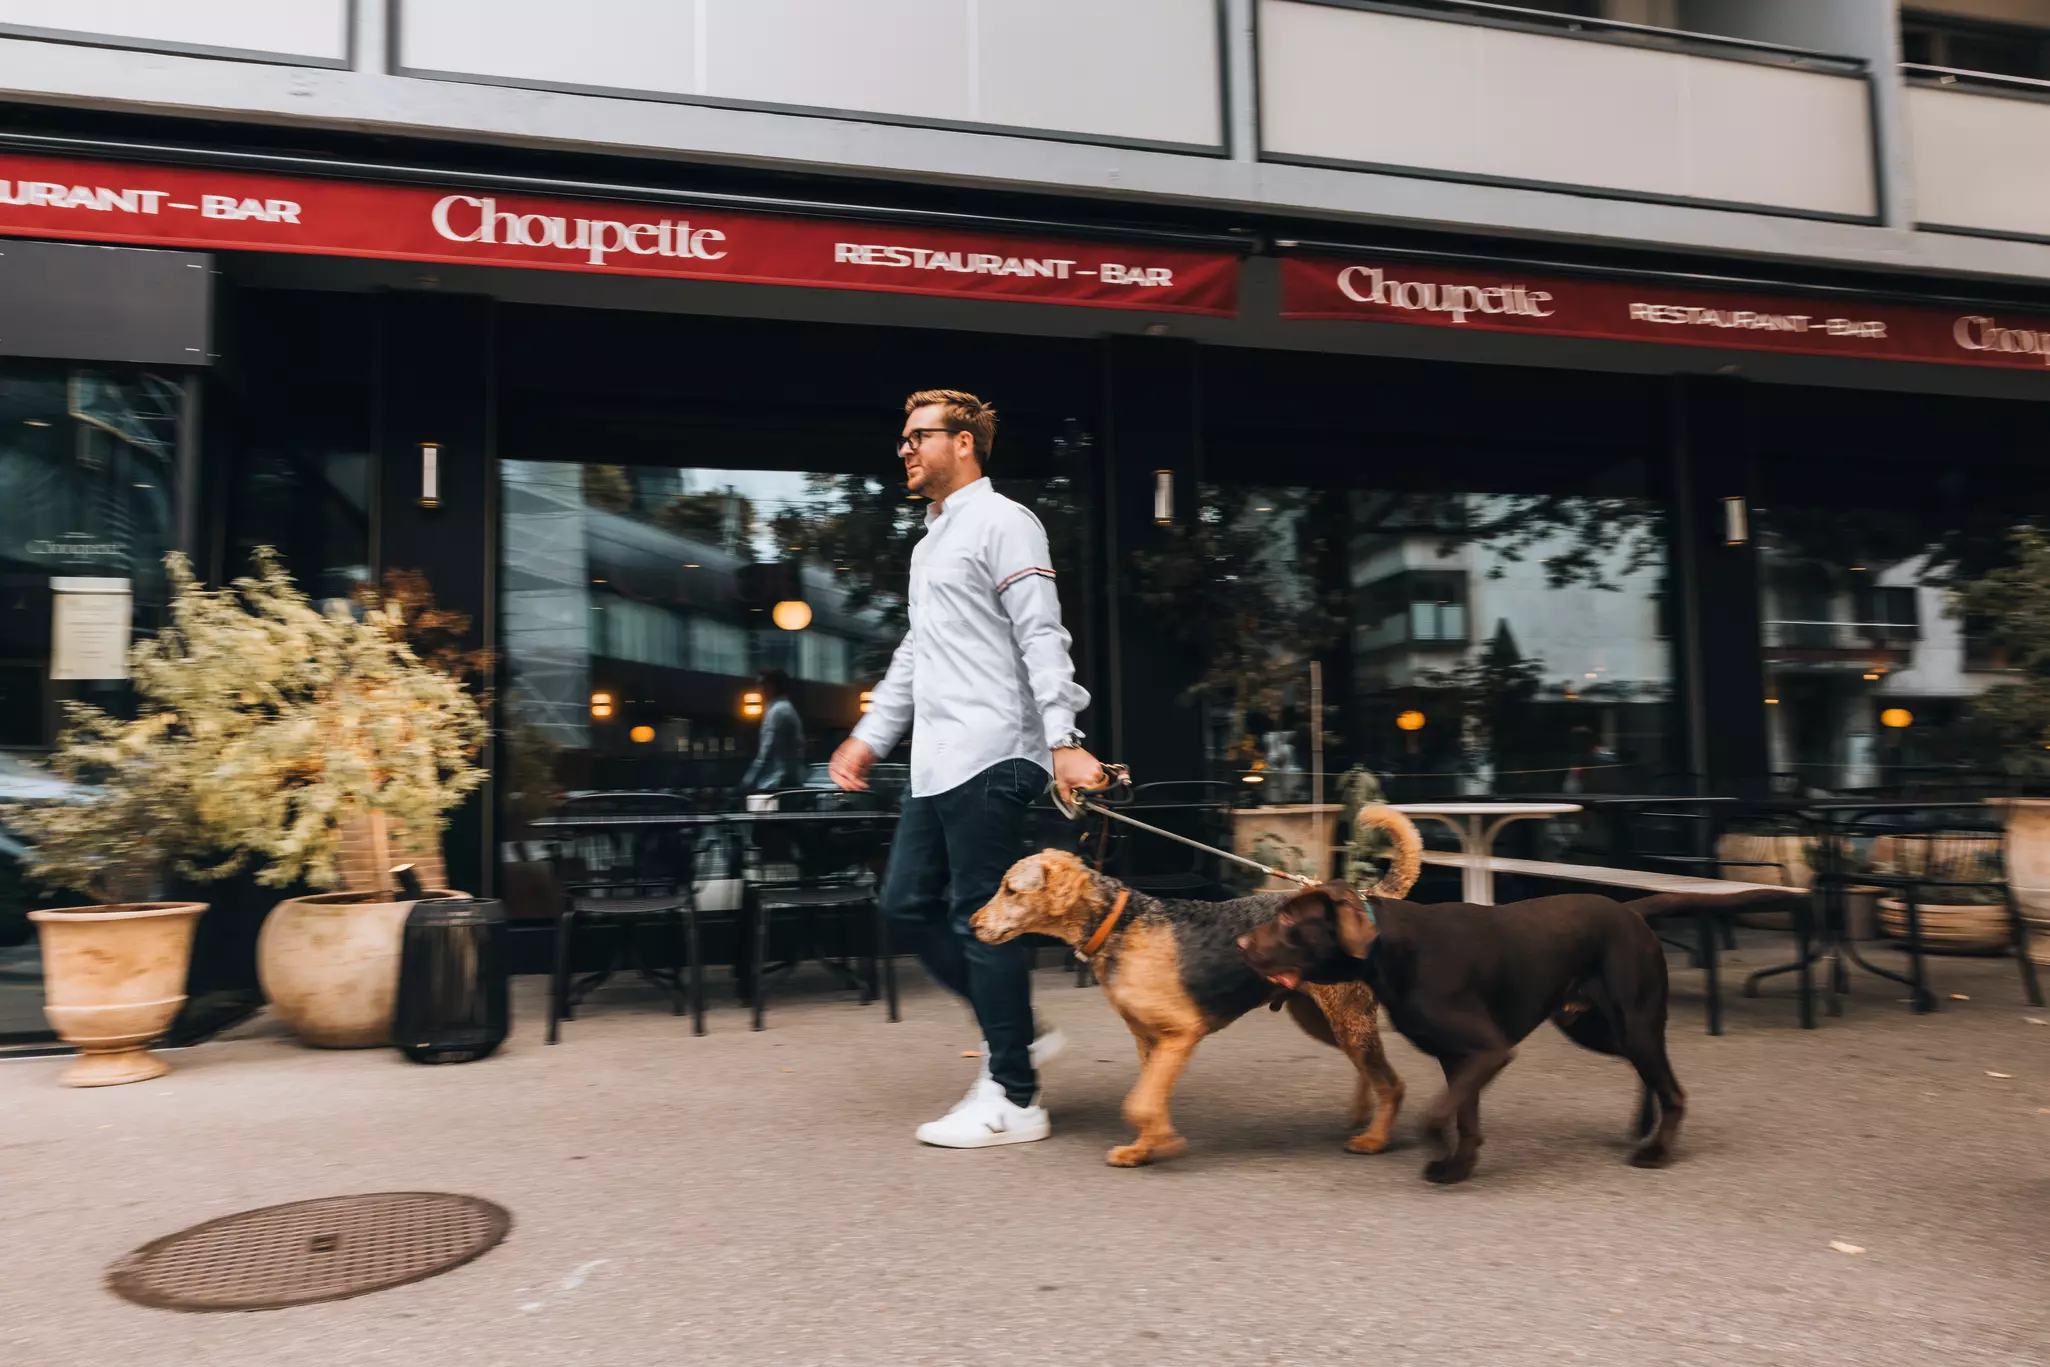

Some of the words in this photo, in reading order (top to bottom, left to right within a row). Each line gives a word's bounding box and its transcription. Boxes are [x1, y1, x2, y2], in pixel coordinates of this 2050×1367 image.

[431, 195, 728, 265] Choupette
[1337, 266, 1555, 323] Choupette
[1953, 315, 2050, 365] Chou
